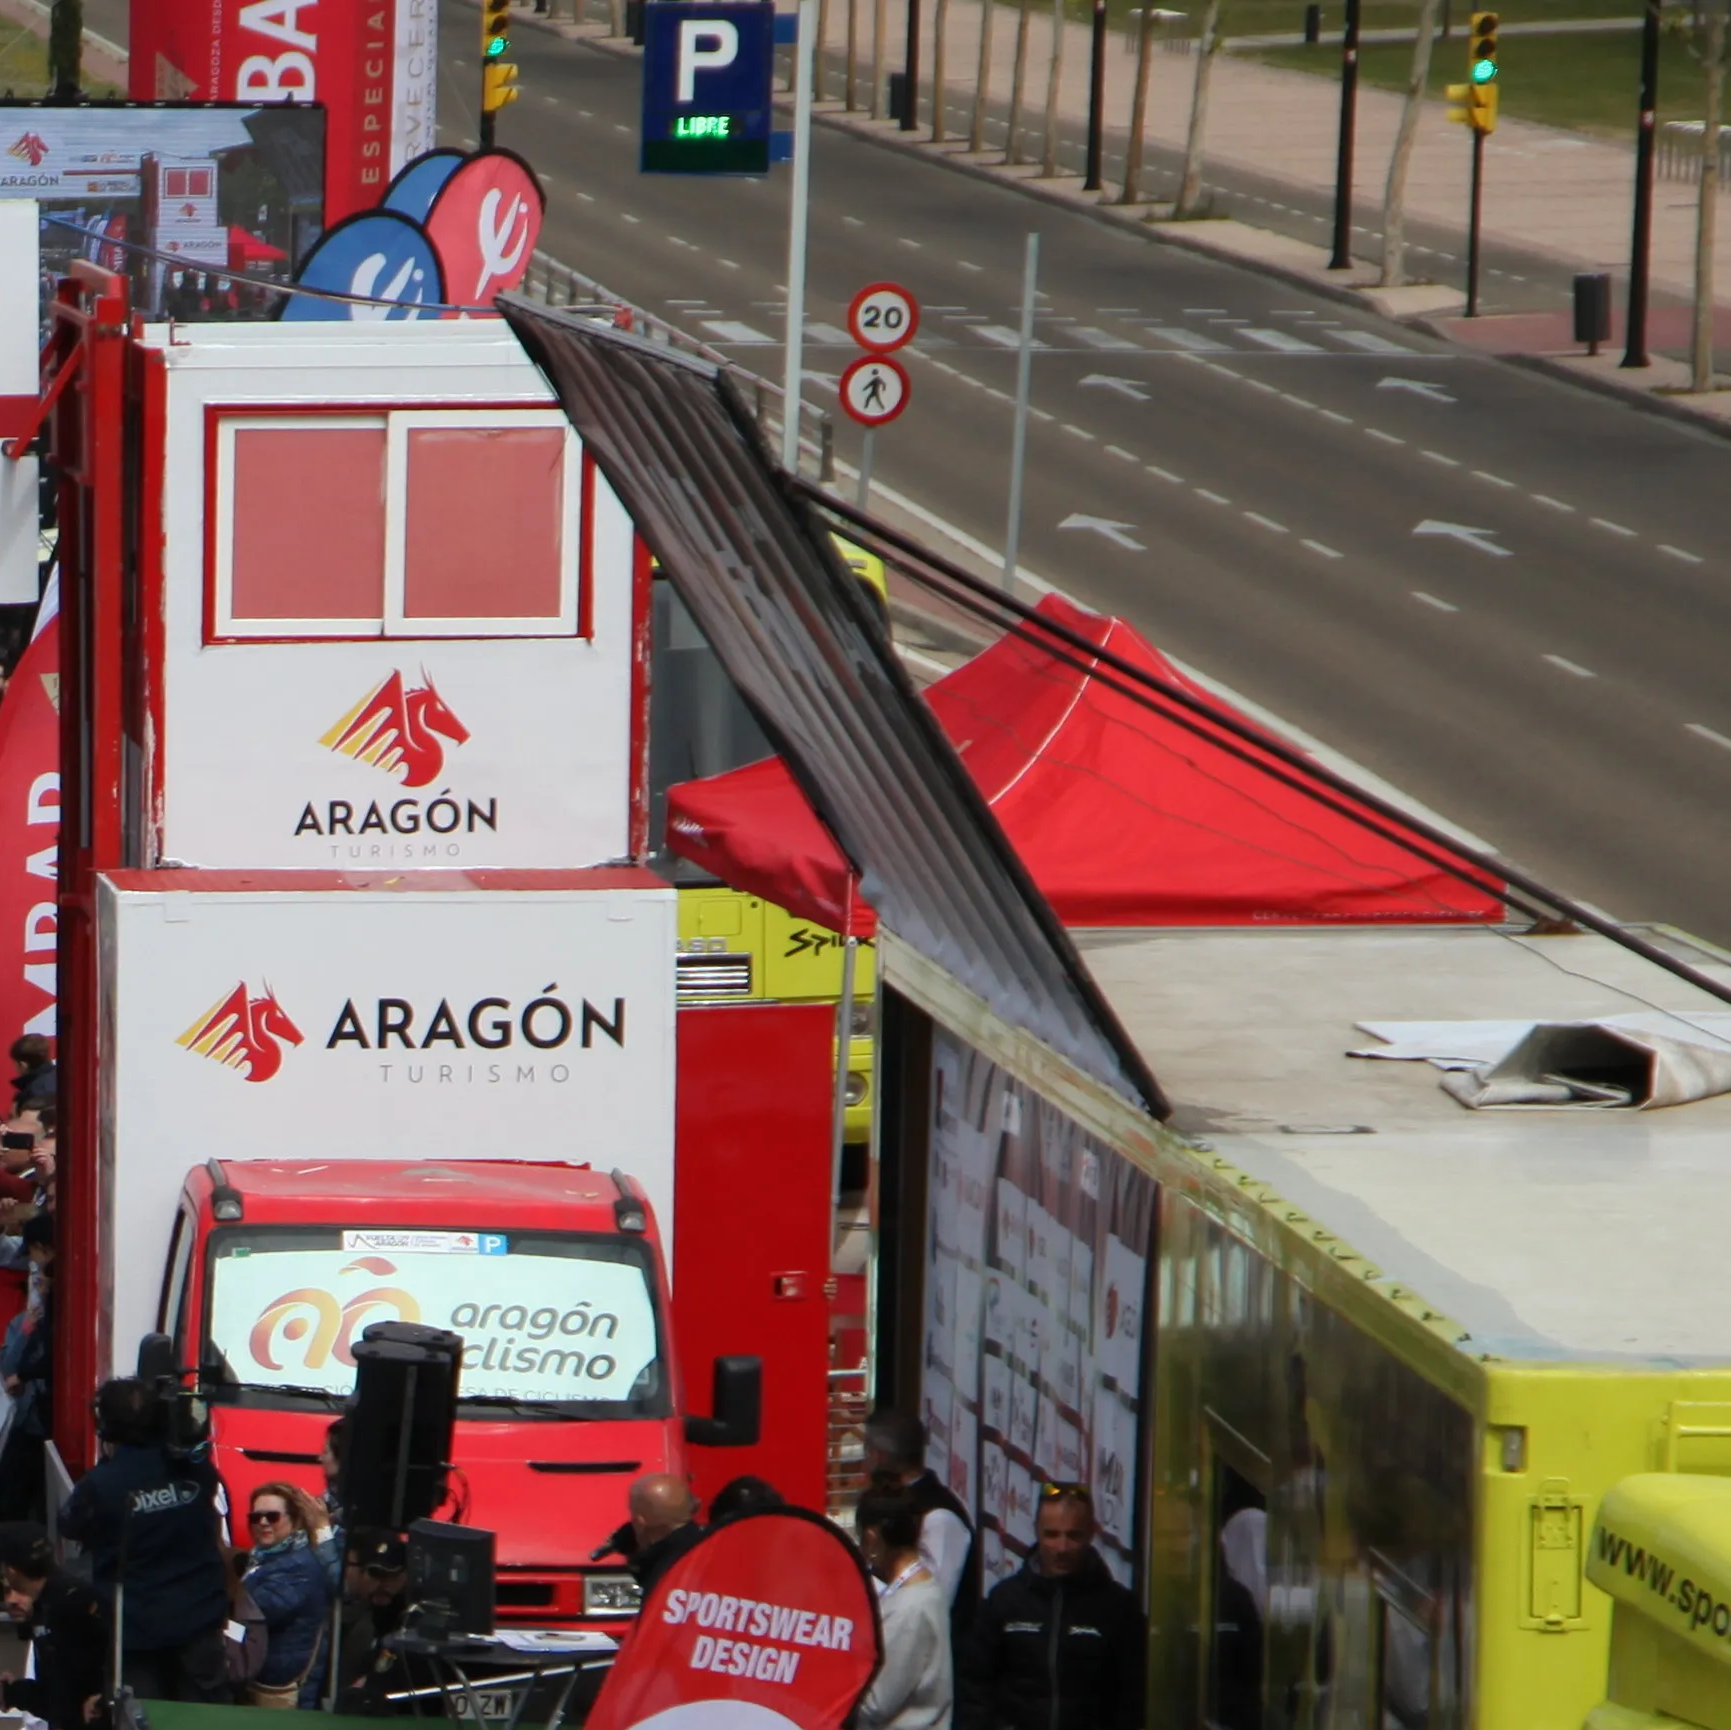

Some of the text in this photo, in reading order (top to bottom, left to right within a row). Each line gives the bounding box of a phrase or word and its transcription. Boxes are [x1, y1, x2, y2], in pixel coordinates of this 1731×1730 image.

[677, 20, 738, 103] P
[361, 0, 386, 184] ESPECIA
[676, 114, 731, 138] LIBRE
[862, 304, 904, 331] 20
[294, 788, 499, 837] ARAGÓN
[329, 841, 462, 859] TURISMO
[325, 982, 626, 1051] ARAGÓN
[380, 1062, 571, 1085] TURISMO
[485, 1237, 502, 1254] P
[1596, 1524, 1731, 1648] www.spo
[661, 1586, 853, 1652] SPORTSWEAR
[688, 1634, 801, 1685] DESIGN
